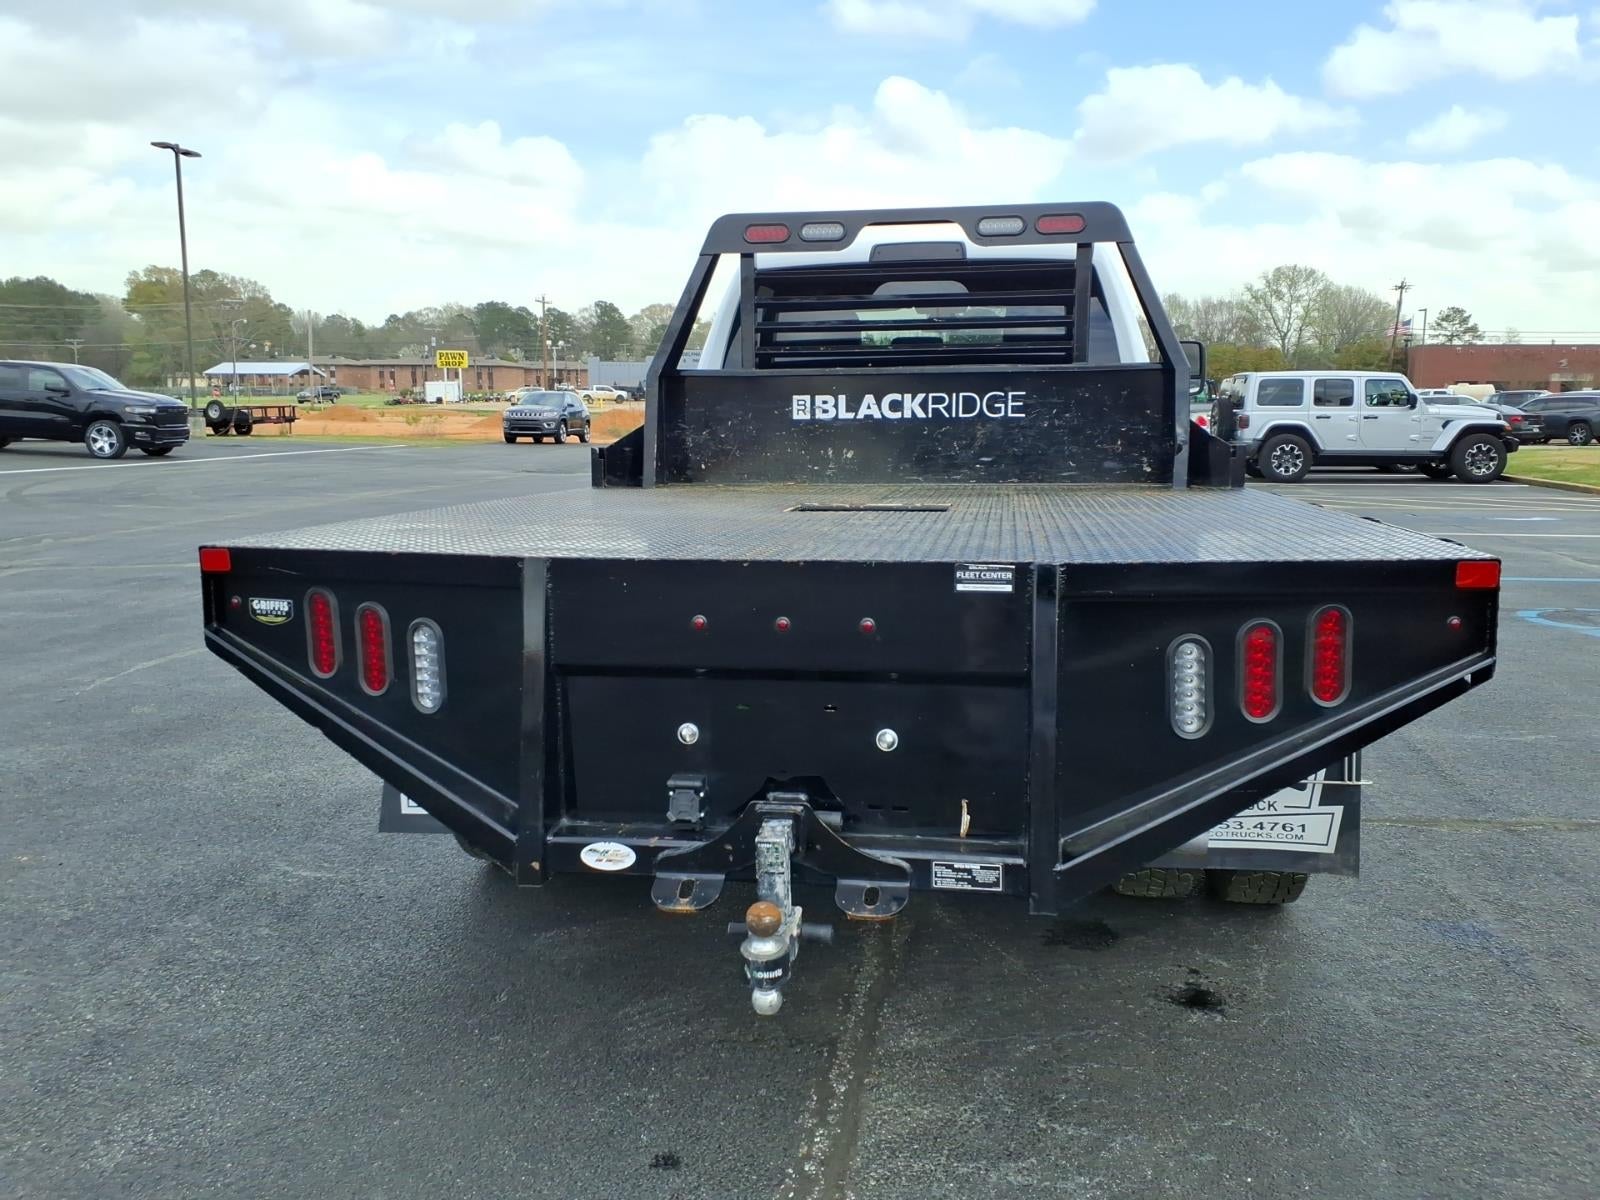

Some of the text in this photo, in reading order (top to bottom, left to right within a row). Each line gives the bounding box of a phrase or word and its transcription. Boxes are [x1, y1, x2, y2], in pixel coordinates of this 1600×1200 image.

[438, 351, 465, 361] PAWN
[815, 391, 1027, 420] BLACKRIDGE
[956, 571, 1013, 579] FLEET CENTER
[252, 599, 289, 611] GRIFFIS
